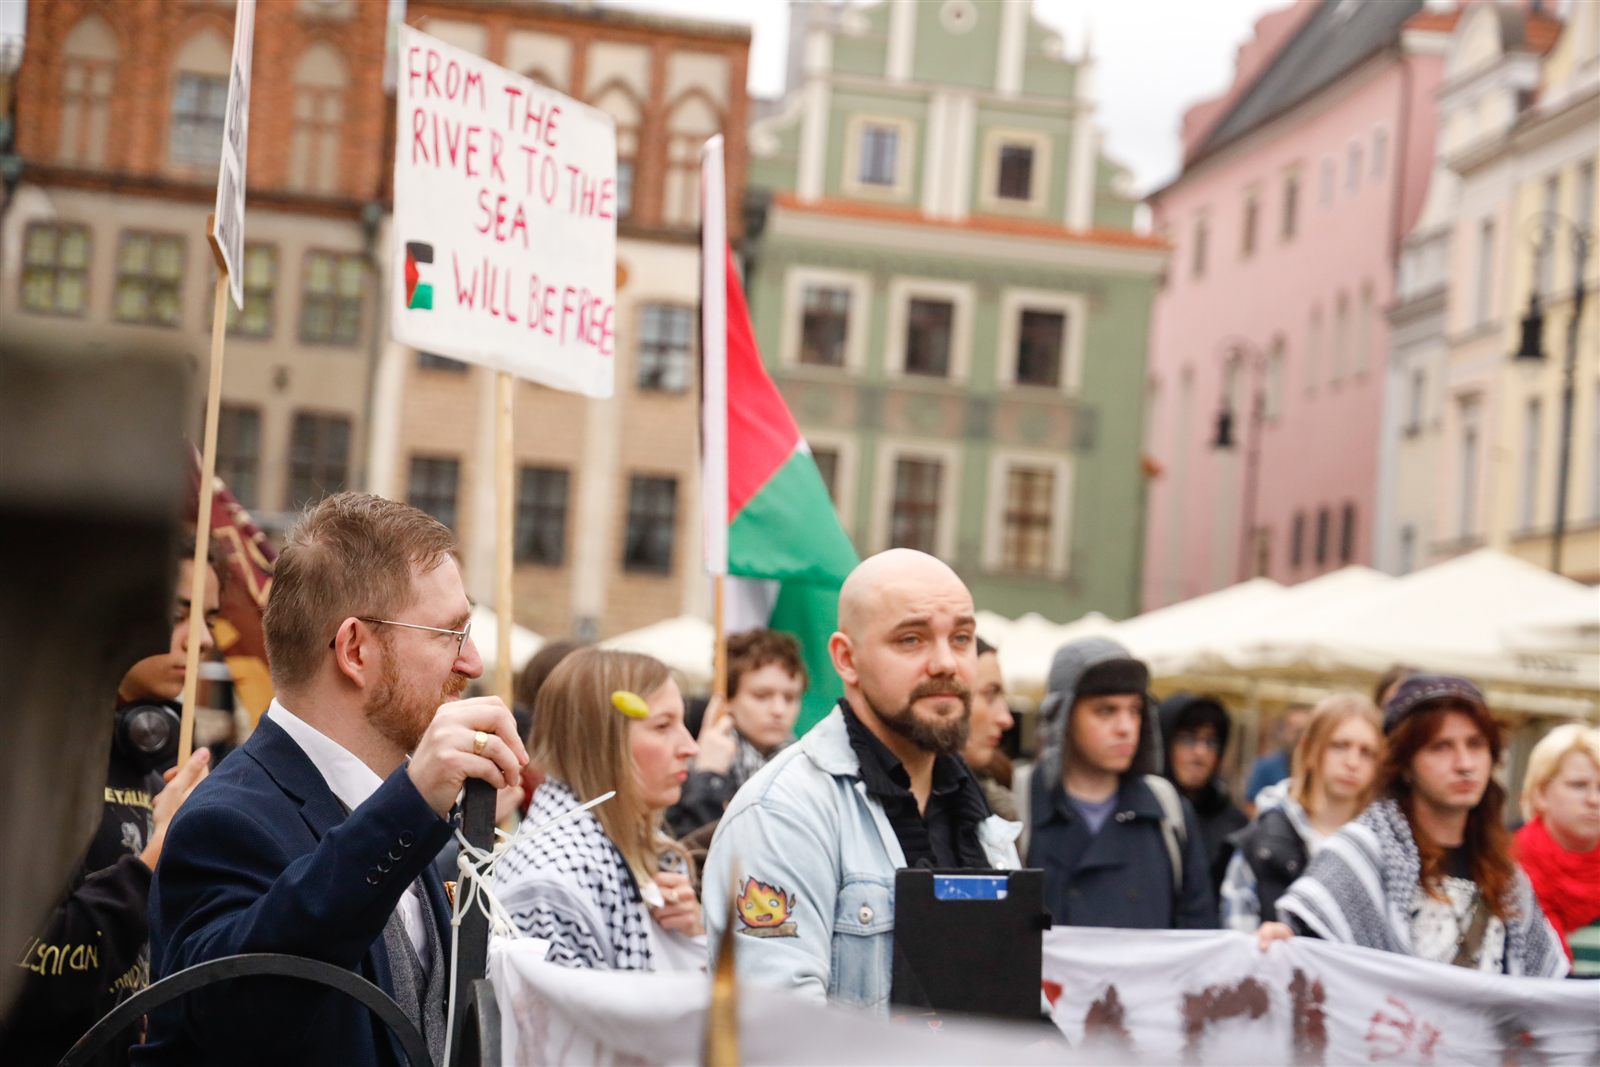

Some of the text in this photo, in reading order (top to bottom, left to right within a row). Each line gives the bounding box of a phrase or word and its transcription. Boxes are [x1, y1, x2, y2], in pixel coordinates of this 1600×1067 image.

[408, 46, 563, 148] FROM THE
[412, 105, 615, 220] RIVER TO THE
[475, 187, 530, 251] SEA
[451, 248, 520, 324] WILL
